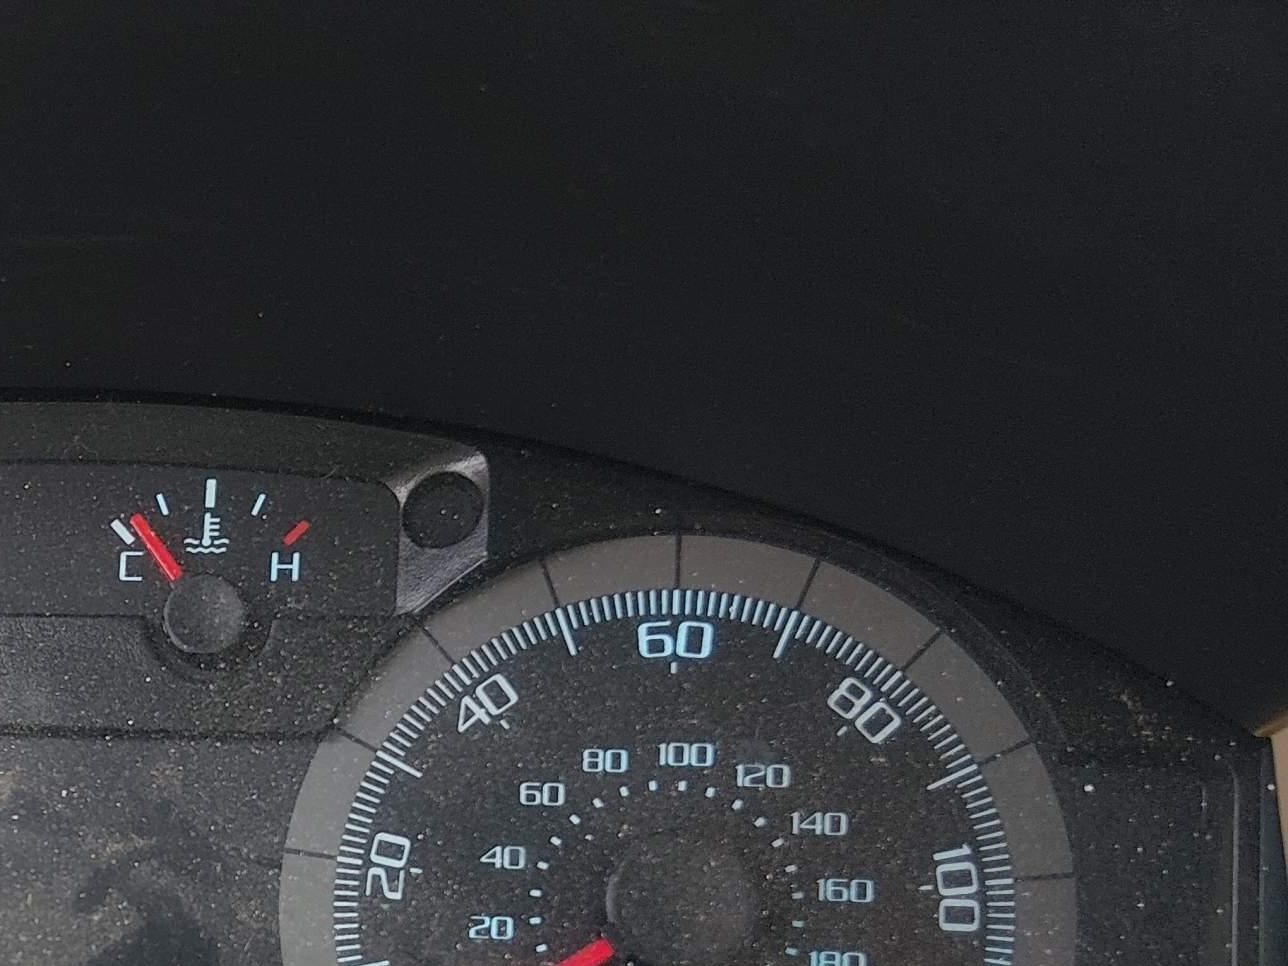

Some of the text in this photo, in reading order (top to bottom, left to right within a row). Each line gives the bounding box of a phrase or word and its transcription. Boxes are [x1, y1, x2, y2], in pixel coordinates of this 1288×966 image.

[118, 552, 143, 583] C
[269, 553, 300, 582] H
[637, 622, 714, 660] 60
[456, 673, 520, 734] 40
[827, 676, 902, 744] 80
[582, 748, 629, 773] 80
[658, 743, 714, 768] 100
[735, 762, 791, 789] 120
[519, 782, 565, 806] 60
[790, 810, 849, 836] 140
[366, 833, 412, 900] 20
[480, 846, 527, 870] 40
[816, 879, 875, 903] 160
[932, 843, 982, 933] 100
[468, 916, 514, 940] 20
